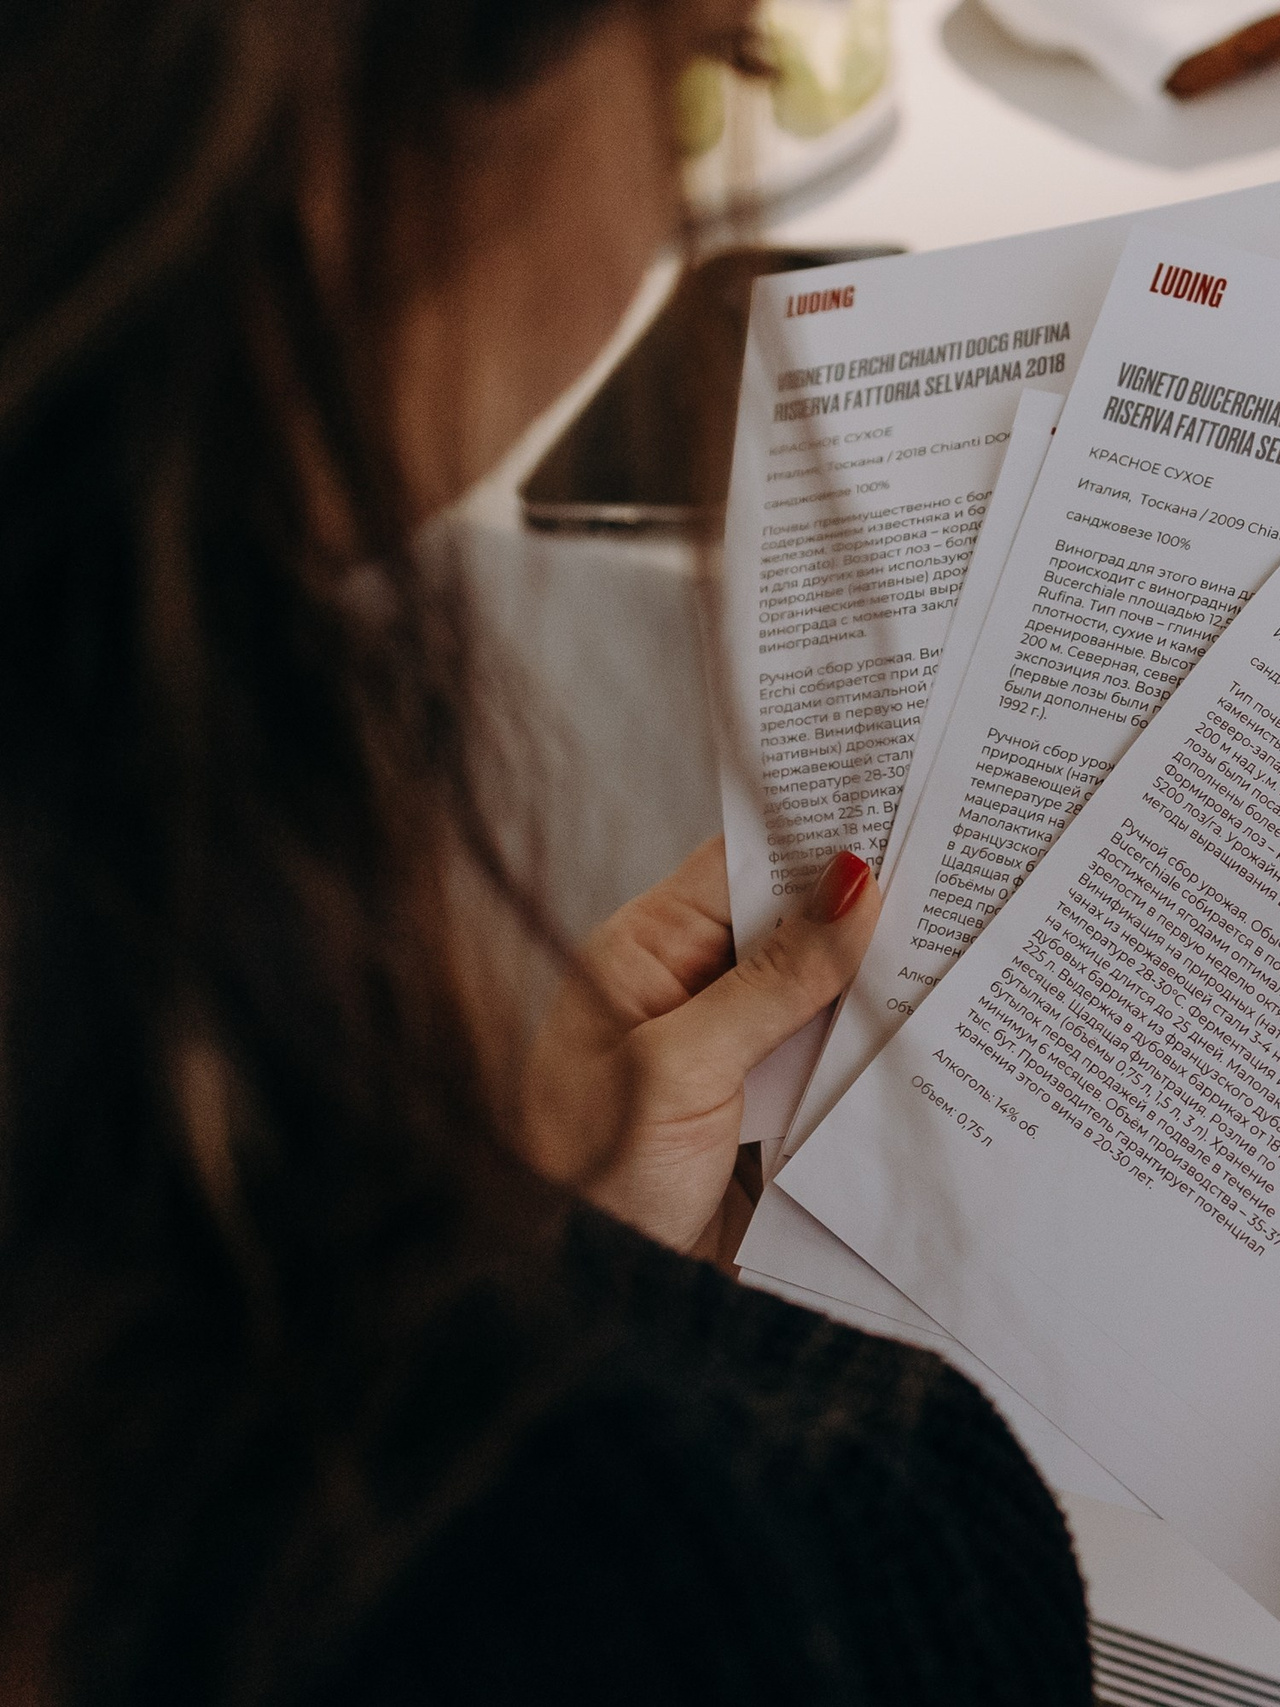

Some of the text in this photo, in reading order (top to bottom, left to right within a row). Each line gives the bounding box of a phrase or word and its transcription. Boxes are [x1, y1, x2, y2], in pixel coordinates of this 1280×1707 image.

[1149, 262, 1227, 308] LUDING
[1117, 361, 1189, 401] VIGNETO
[1102, 395, 1174, 436] RISERVA
[1173, 413, 1255, 456] FATTORIA
[1088, 447, 1214, 488] КРАСНОЕ СУХОЕ
[1077, 477, 1131, 502] Италия,
[1141, 493, 1197, 518] Тоскана
[1208, 511, 1244, 529] 2009
[1066, 510, 1190, 550] санджовезе 100%
[1049, 556, 1145, 589] происходит с
[1054, 539, 1235, 596] Виноград для этого вина
[1037, 585, 1153, 625] Rufina. Тип почв
[1043, 570, 1205, 622] Bucerchiale площадью
[1024, 619, 1145, 658] дренированные.
[1031, 603, 1166, 646] плотности, сухие и
[1229, 680, 1253, 705] Тип
[1171, 751, 1244, 808] дополнены
[1183, 737, 1217, 764] лозы
[1217, 760, 1251, 790] были
[1194, 721, 1220, 744] 200
[1219, 742, 1231, 754] м
[1230, 751, 1256, 775] над
[1252, 769, 1277, 790] у.м.
[1152, 776, 1184, 804] 5200
[1182, 802, 1222, 837] лоз/га.
[1164, 763, 1242, 828] Формировка
[1241, 826, 1266, 847] лоз
[1142, 792, 1189, 831] методы
[1189, 828, 1278, 900] выращивания
[911, 1075, 992, 1146] Объем: 0,75 л
[932, 1049, 1038, 1139] Алкоголь: 14% об.
[954, 1021, 1153, 1189] хранения этого вина в 20-30 лет.
